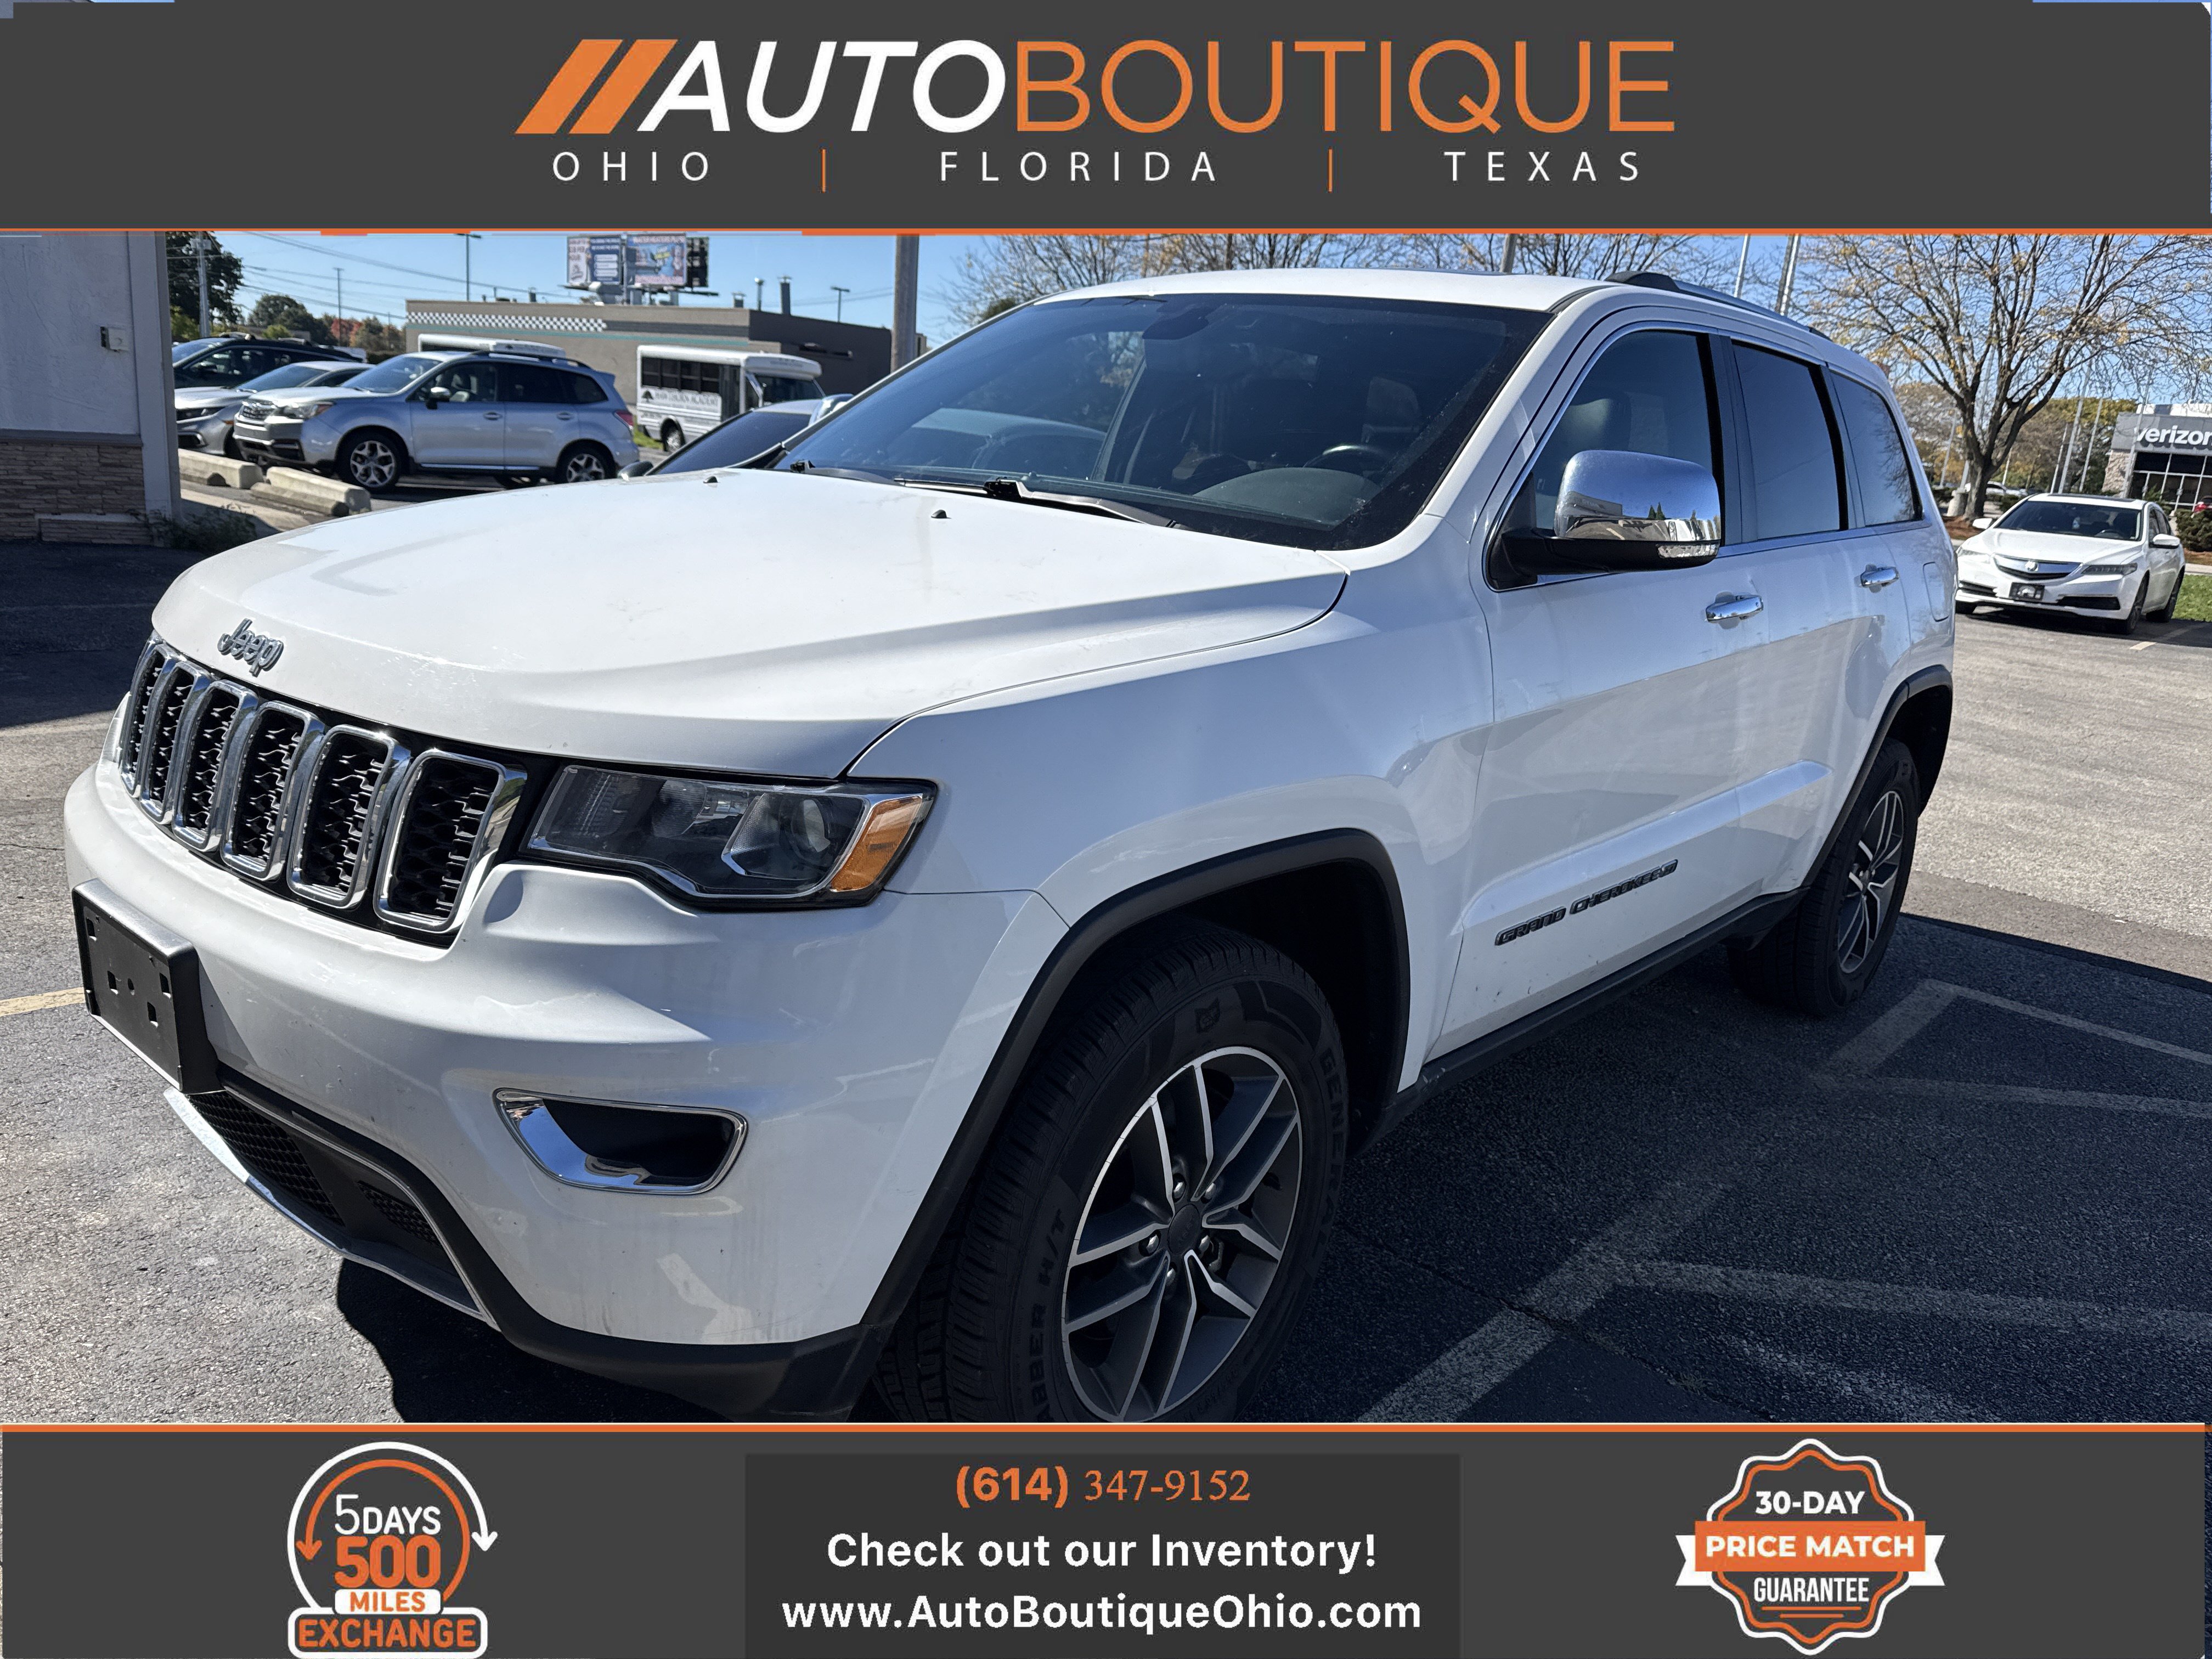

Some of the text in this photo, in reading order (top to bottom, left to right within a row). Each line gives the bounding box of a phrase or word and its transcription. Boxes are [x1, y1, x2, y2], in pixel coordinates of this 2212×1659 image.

[217, 618, 284, 678] Jeep
[1494, 859, 1678, 946] GRAND CHEROKEE
